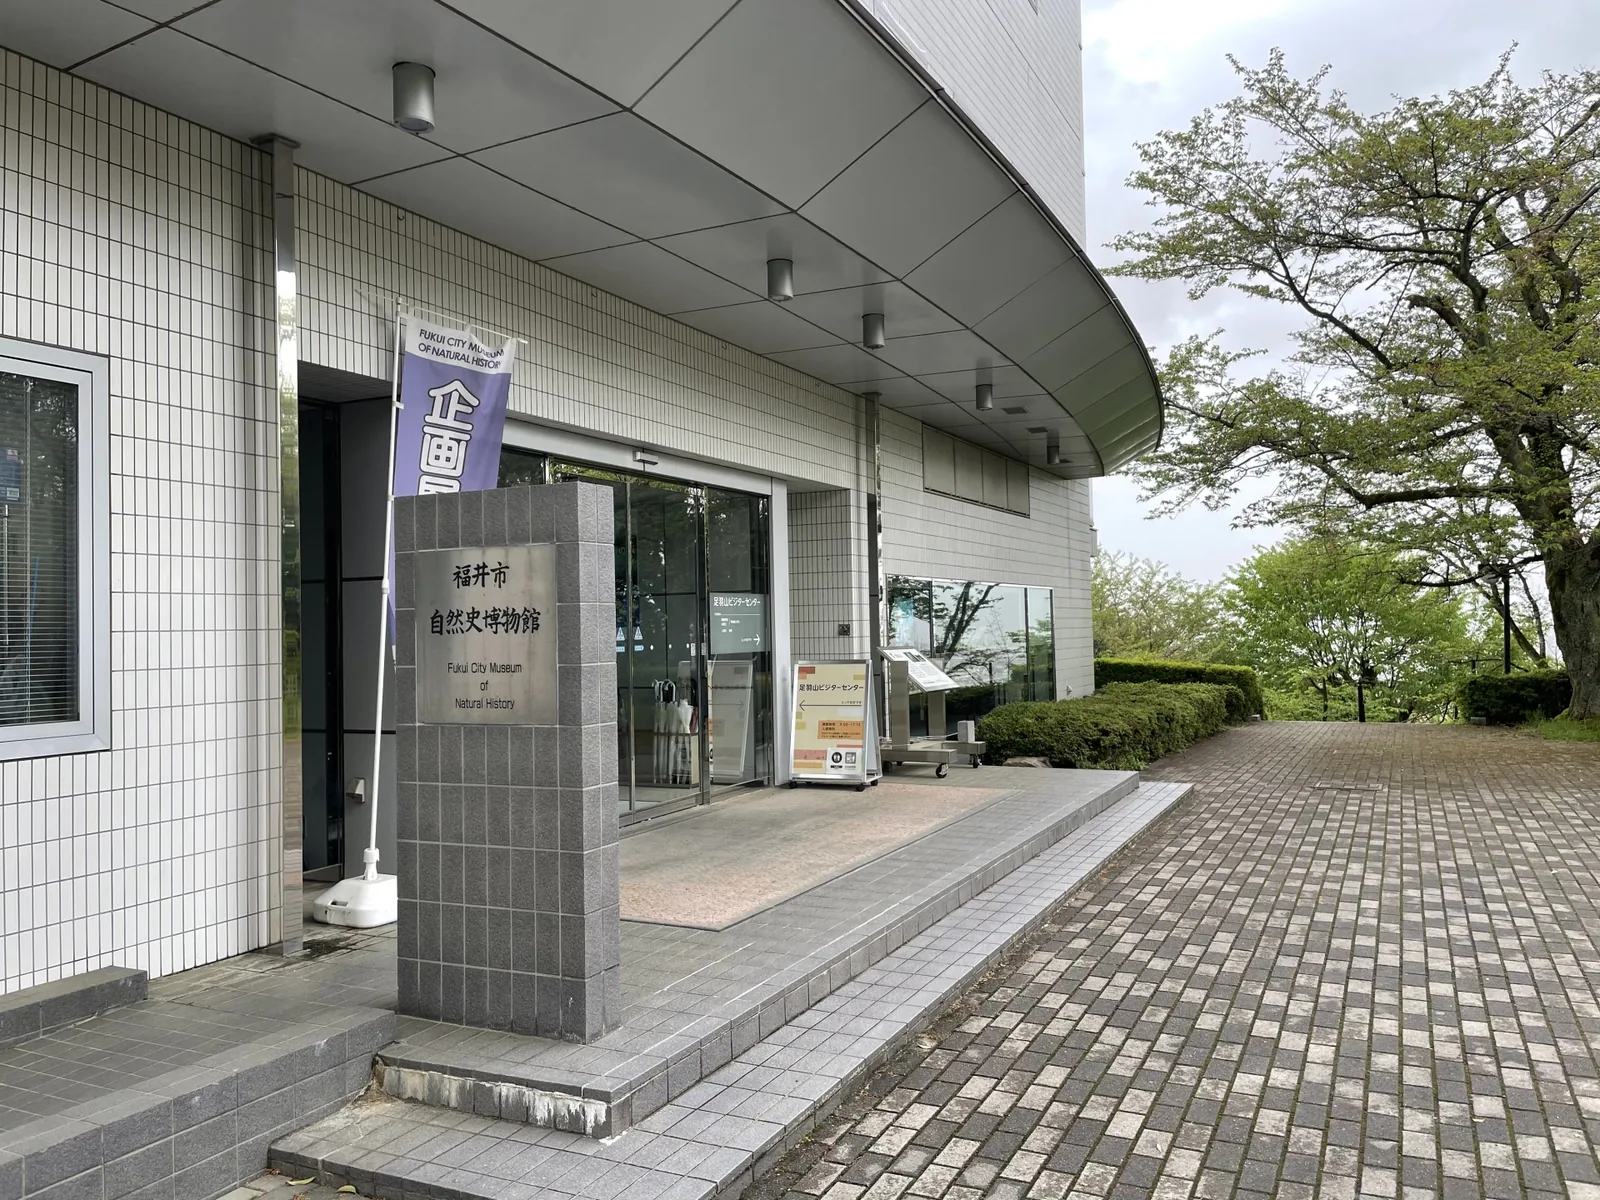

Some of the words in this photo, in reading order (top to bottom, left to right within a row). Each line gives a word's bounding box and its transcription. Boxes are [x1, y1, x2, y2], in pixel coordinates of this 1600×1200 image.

[419, 328, 446, 345] FUKUI
[447, 337, 468, 349] CITY
[418, 342, 432, 354] OF
[431, 346, 471, 364] NATURAL
[452, 561, 510, 589] 福井市
[430, 606, 541, 636] 自然史博物館
[447, 662, 469, 674] Fukui
[471, 662, 487, 674] City
[489, 662, 523, 674] Museum
[480, 680, 489, 691] of
[799, 683, 864, 692] 足羽山ビジターセンター
[455, 698, 484, 709] Natural
[486, 698, 515, 710] History
